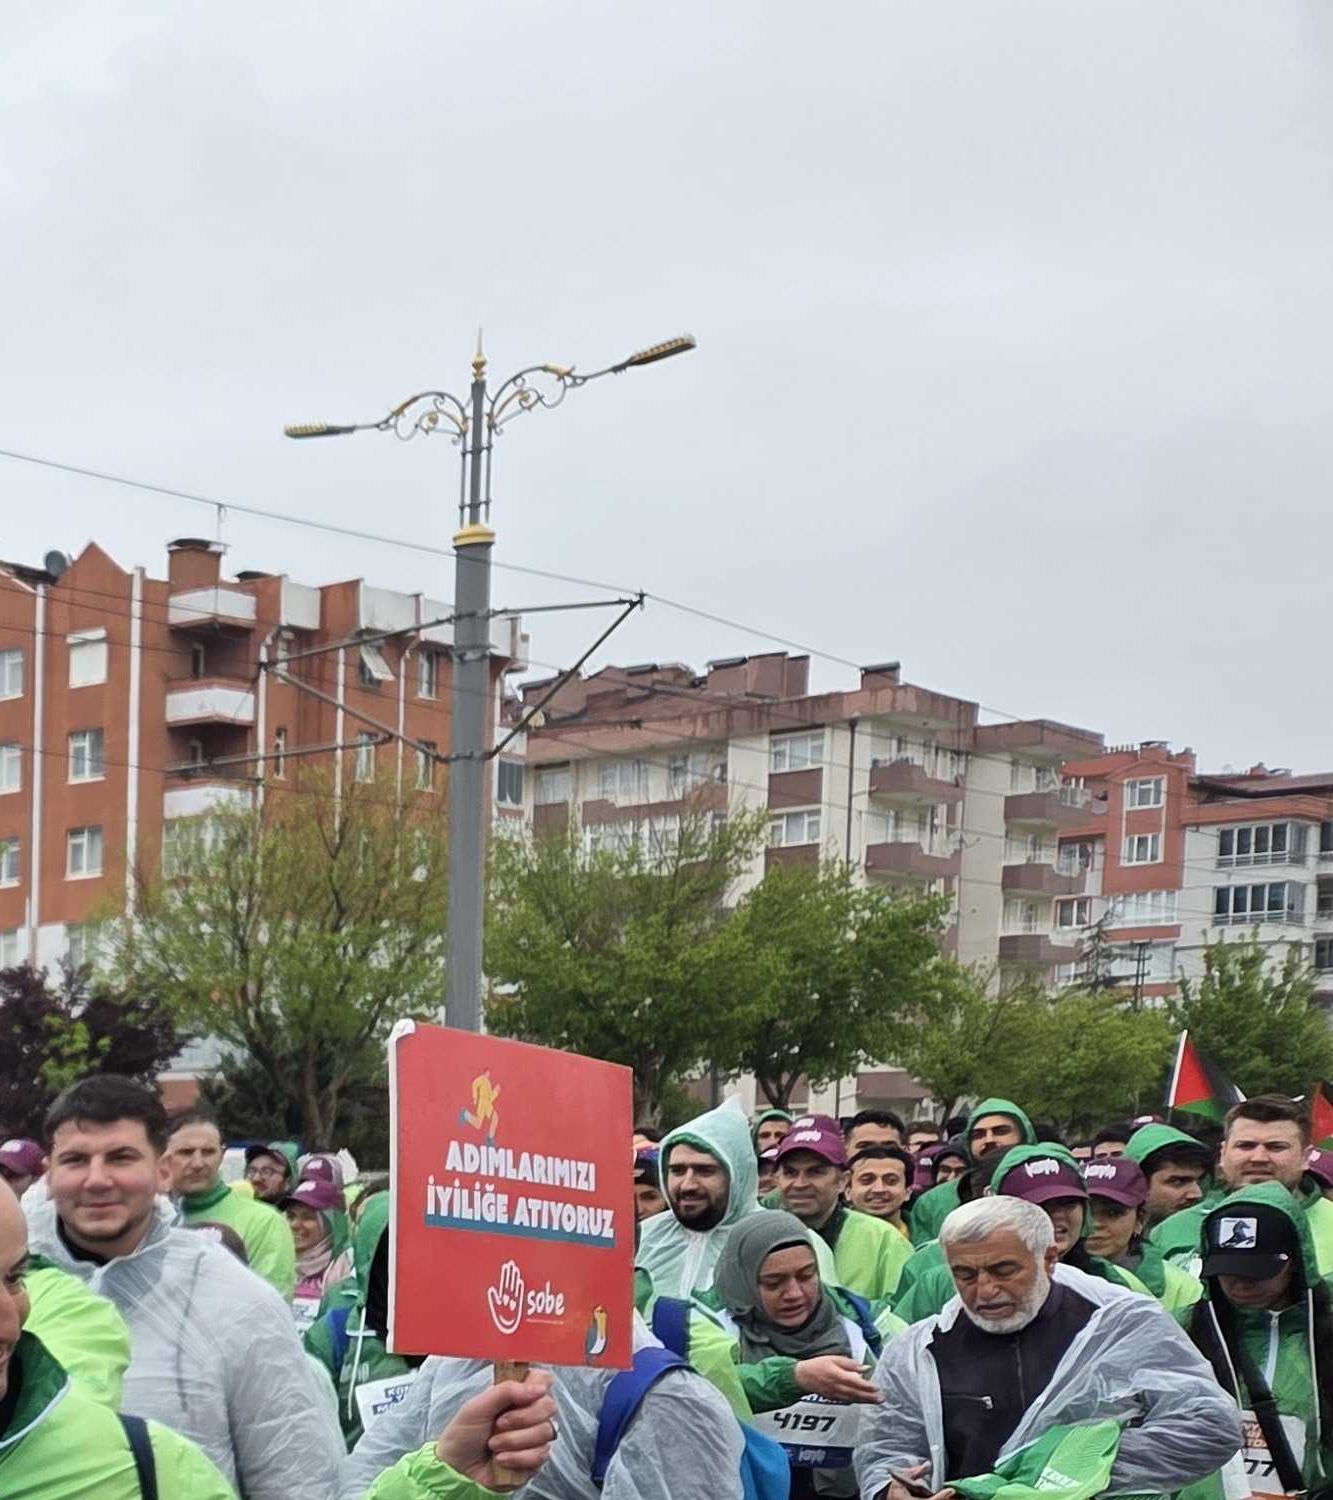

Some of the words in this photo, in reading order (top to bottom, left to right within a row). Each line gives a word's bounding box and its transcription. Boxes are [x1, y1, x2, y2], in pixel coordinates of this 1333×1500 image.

[445, 1140, 595, 1192] ADIMLARIMIZI
[427, 1174, 508, 1224] İYİLİĞE
[513, 1197, 614, 1238] ATIYORUZ
[527, 1280, 565, 1316] sobe
[774, 1412, 837, 1432] 4197
